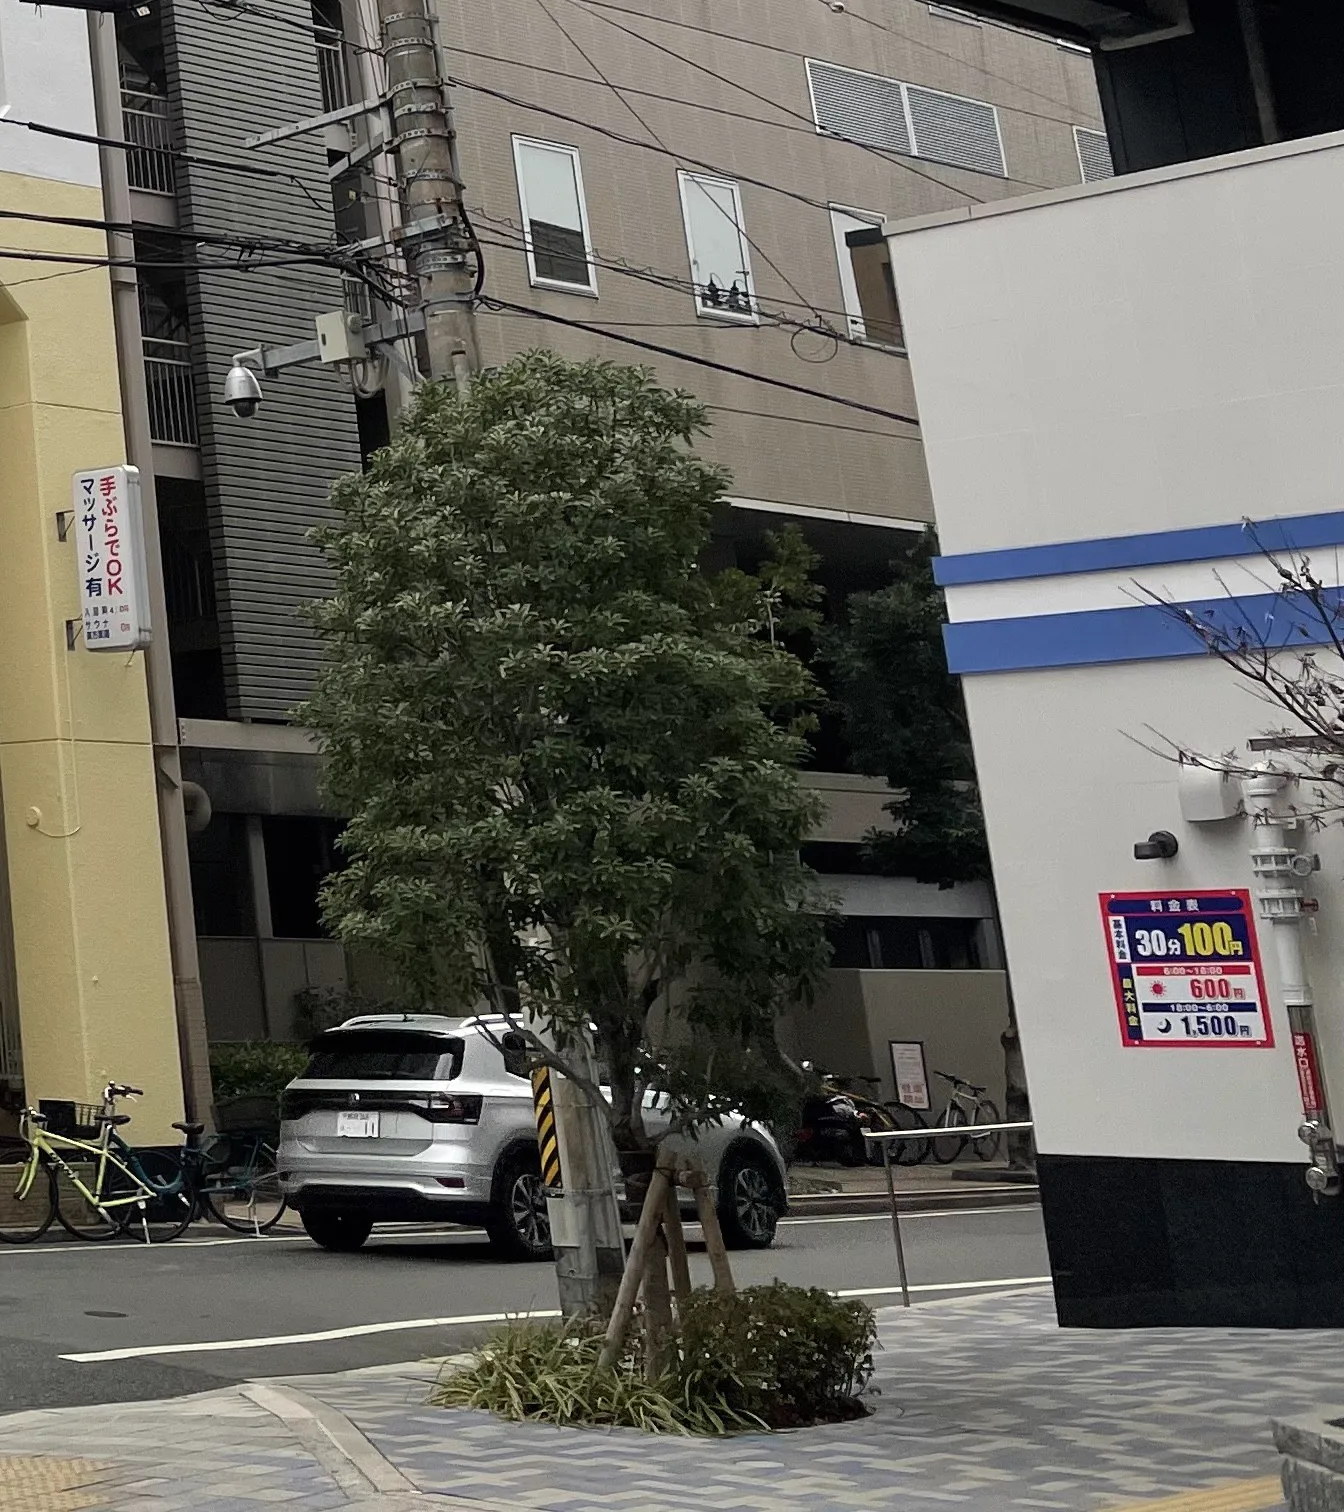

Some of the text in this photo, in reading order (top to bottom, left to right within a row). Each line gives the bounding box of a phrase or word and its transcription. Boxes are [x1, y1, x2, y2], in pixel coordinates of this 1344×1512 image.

[80, 478, 103, 598] マッサージ有
[99, 475, 124, 596] 手ぶらでOK
[1150, 899, 1200, 912] 料金表
[1135, 921, 1243, 956] 30分 100円
[1189, 978, 1246, 1000] 600円
[1181, 1015, 1252, 1038] 1,500円
